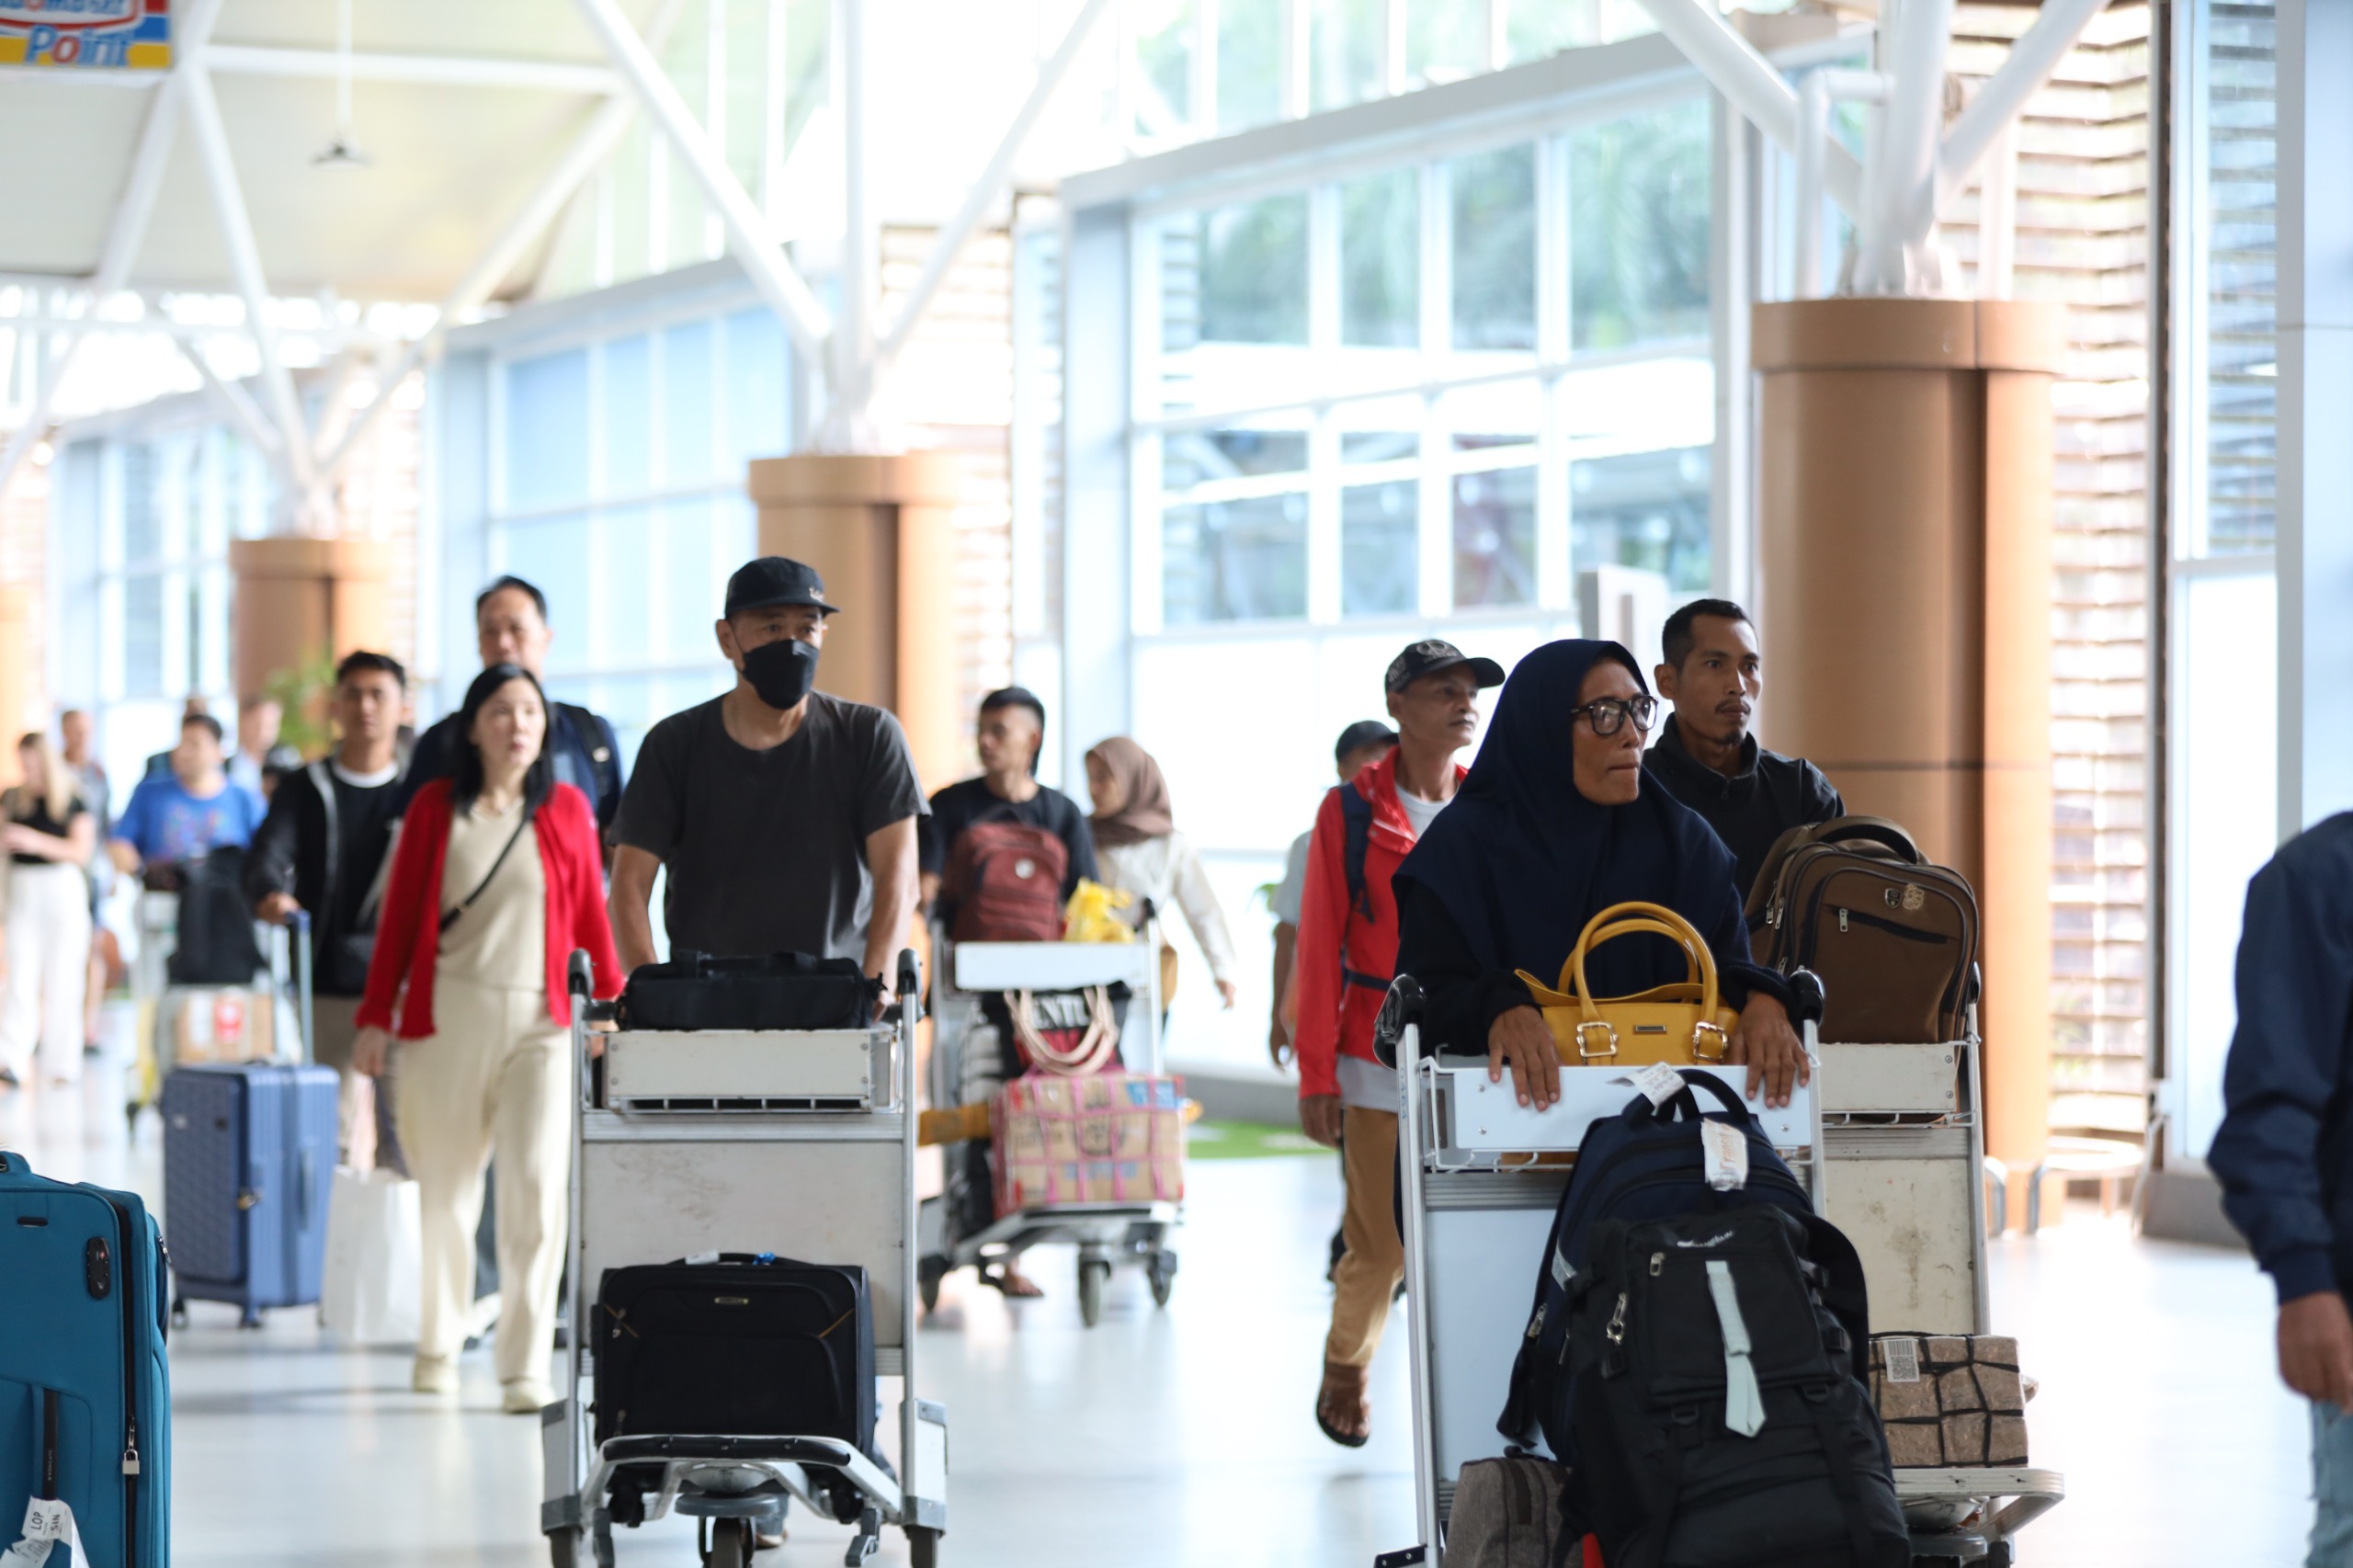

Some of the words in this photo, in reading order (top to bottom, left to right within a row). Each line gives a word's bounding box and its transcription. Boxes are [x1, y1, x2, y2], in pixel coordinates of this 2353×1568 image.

[25, 25, 129, 68] Point
[30, 1511, 44, 1530] LOP
[51, 1514, 61, 1531] SIN
